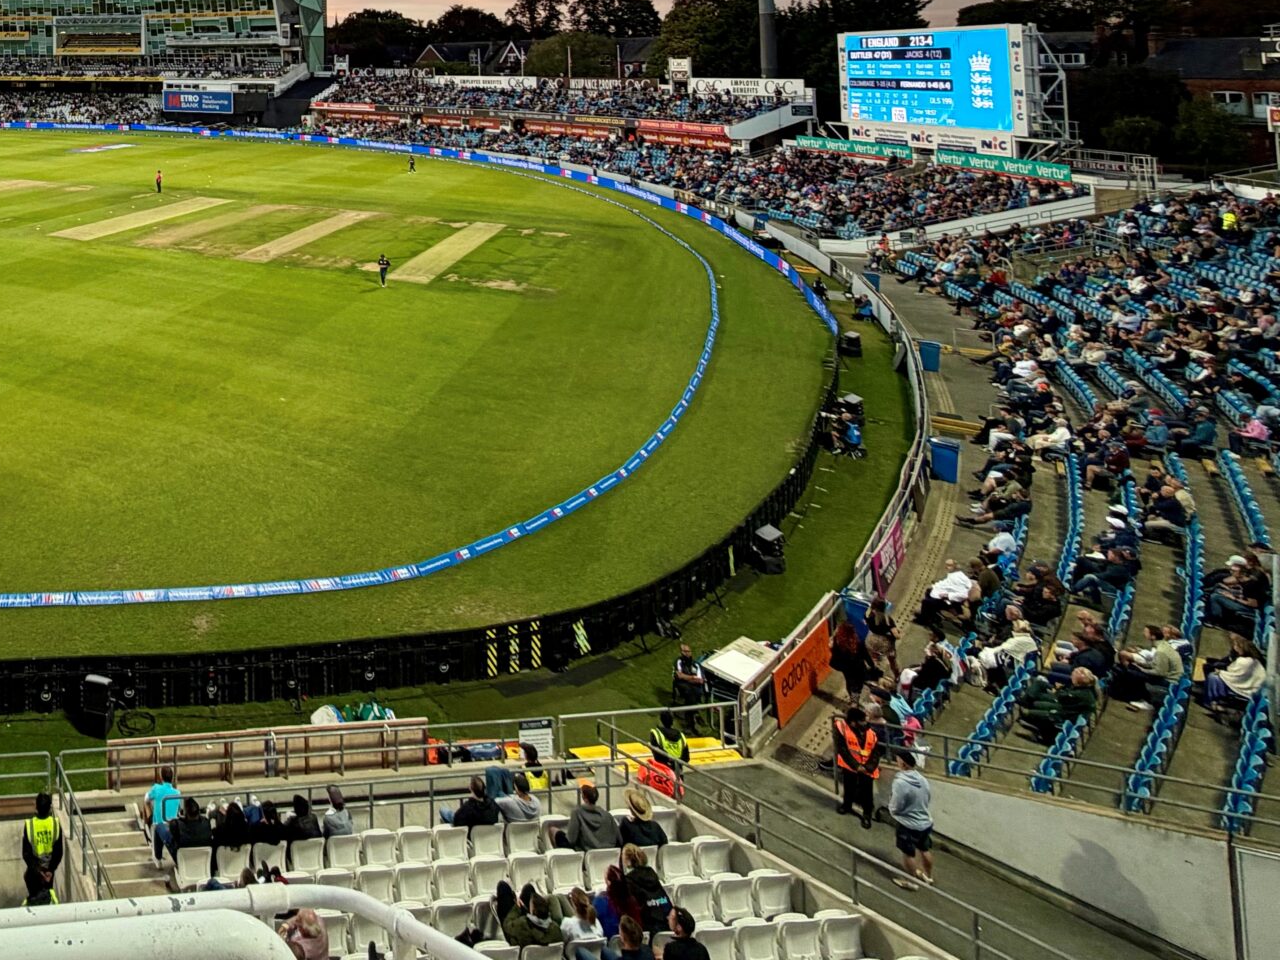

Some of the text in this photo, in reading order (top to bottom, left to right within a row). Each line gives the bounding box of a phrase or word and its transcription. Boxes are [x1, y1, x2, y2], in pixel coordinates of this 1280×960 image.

[867, 35, 933, 47] ENGLAND 213-4
[904, 50, 924, 58] JACKS
[508, 78, 531, 88] C&C
[696, 79, 722, 94] C&C
[764, 80, 794, 96] C&C
[168, 93, 199, 108] METRO
[852, 126, 871, 138] NiC
[910, 130, 934, 143] NiC
[798, 138, 820, 148] Vertu
[826, 140, 847, 150] Vertu
[853, 144, 876, 154] Vertu
[981, 136, 1008, 150] NiC
[937, 152, 962, 165] Vertu
[969, 156, 994, 170] Vertu
[1002, 160, 1028, 174] Vertu
[1036, 165, 1064, 179] Vertu
